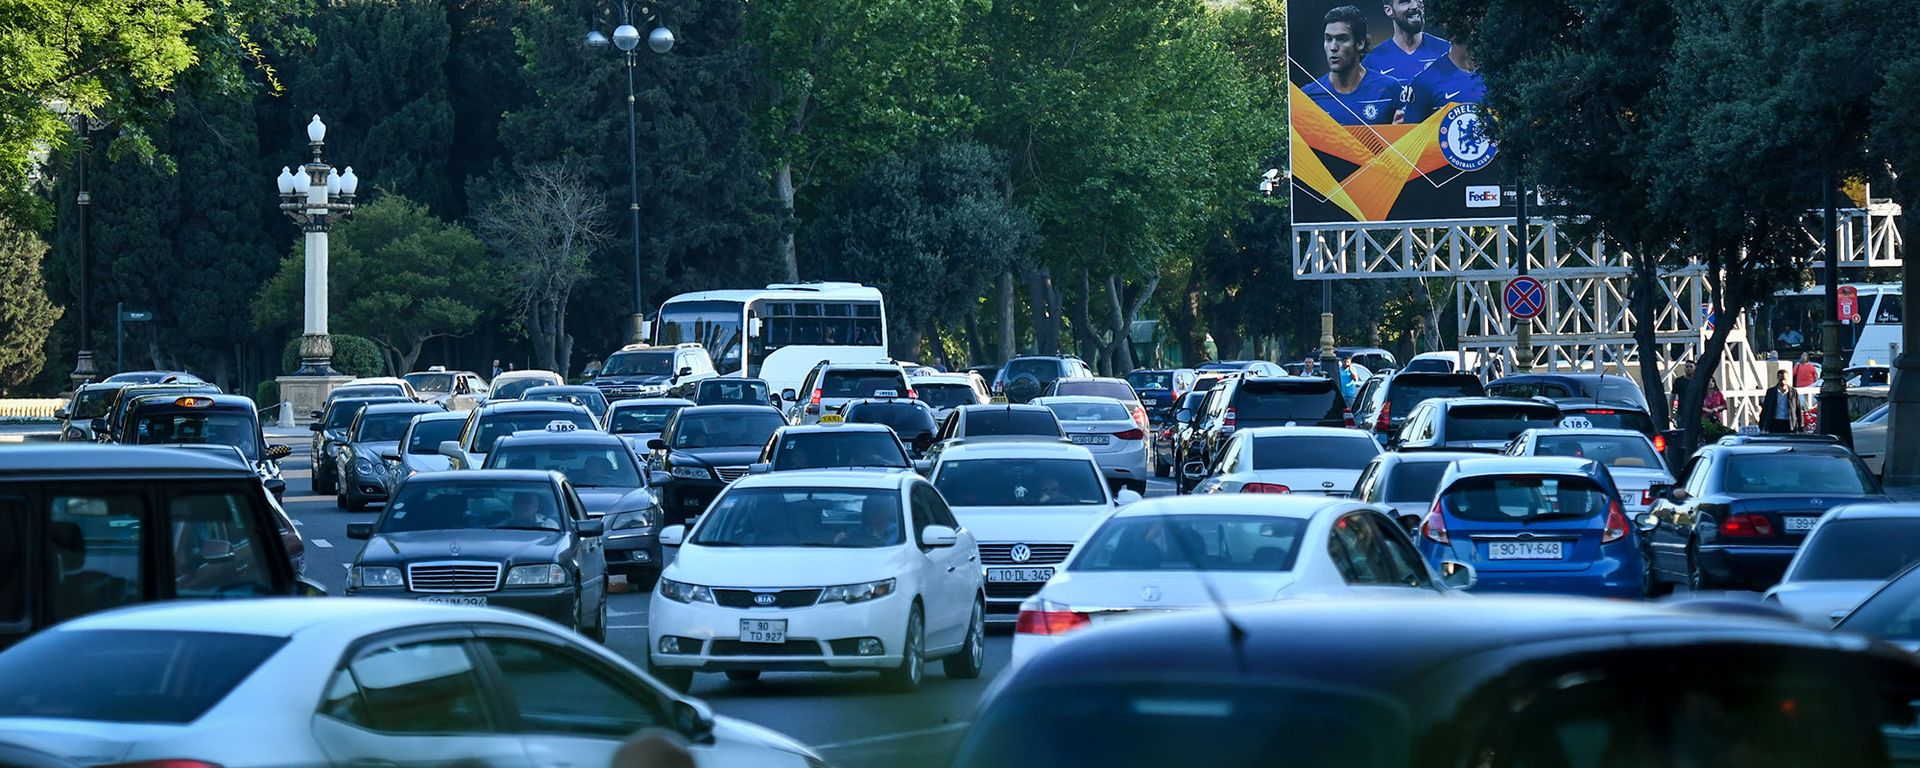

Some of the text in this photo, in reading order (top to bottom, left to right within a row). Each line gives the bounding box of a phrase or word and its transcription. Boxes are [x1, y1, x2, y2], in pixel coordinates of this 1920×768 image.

[1448, 104, 1481, 120] CHELS
[1449, 155, 1490, 168] FOOTBALL CLUB
[1468, 191, 1497, 201] FedEx
[556, 424, 576, 432] 189
[1571, 421, 1590, 429] 189
[1500, 543, 1560, 555] 90-TV-648
[1000, 569, 1051, 581] 10-DL-345
[756, 595, 773, 604] KIA
[757, 622, 769, 631] 90
[765, 632, 782, 641] 927
